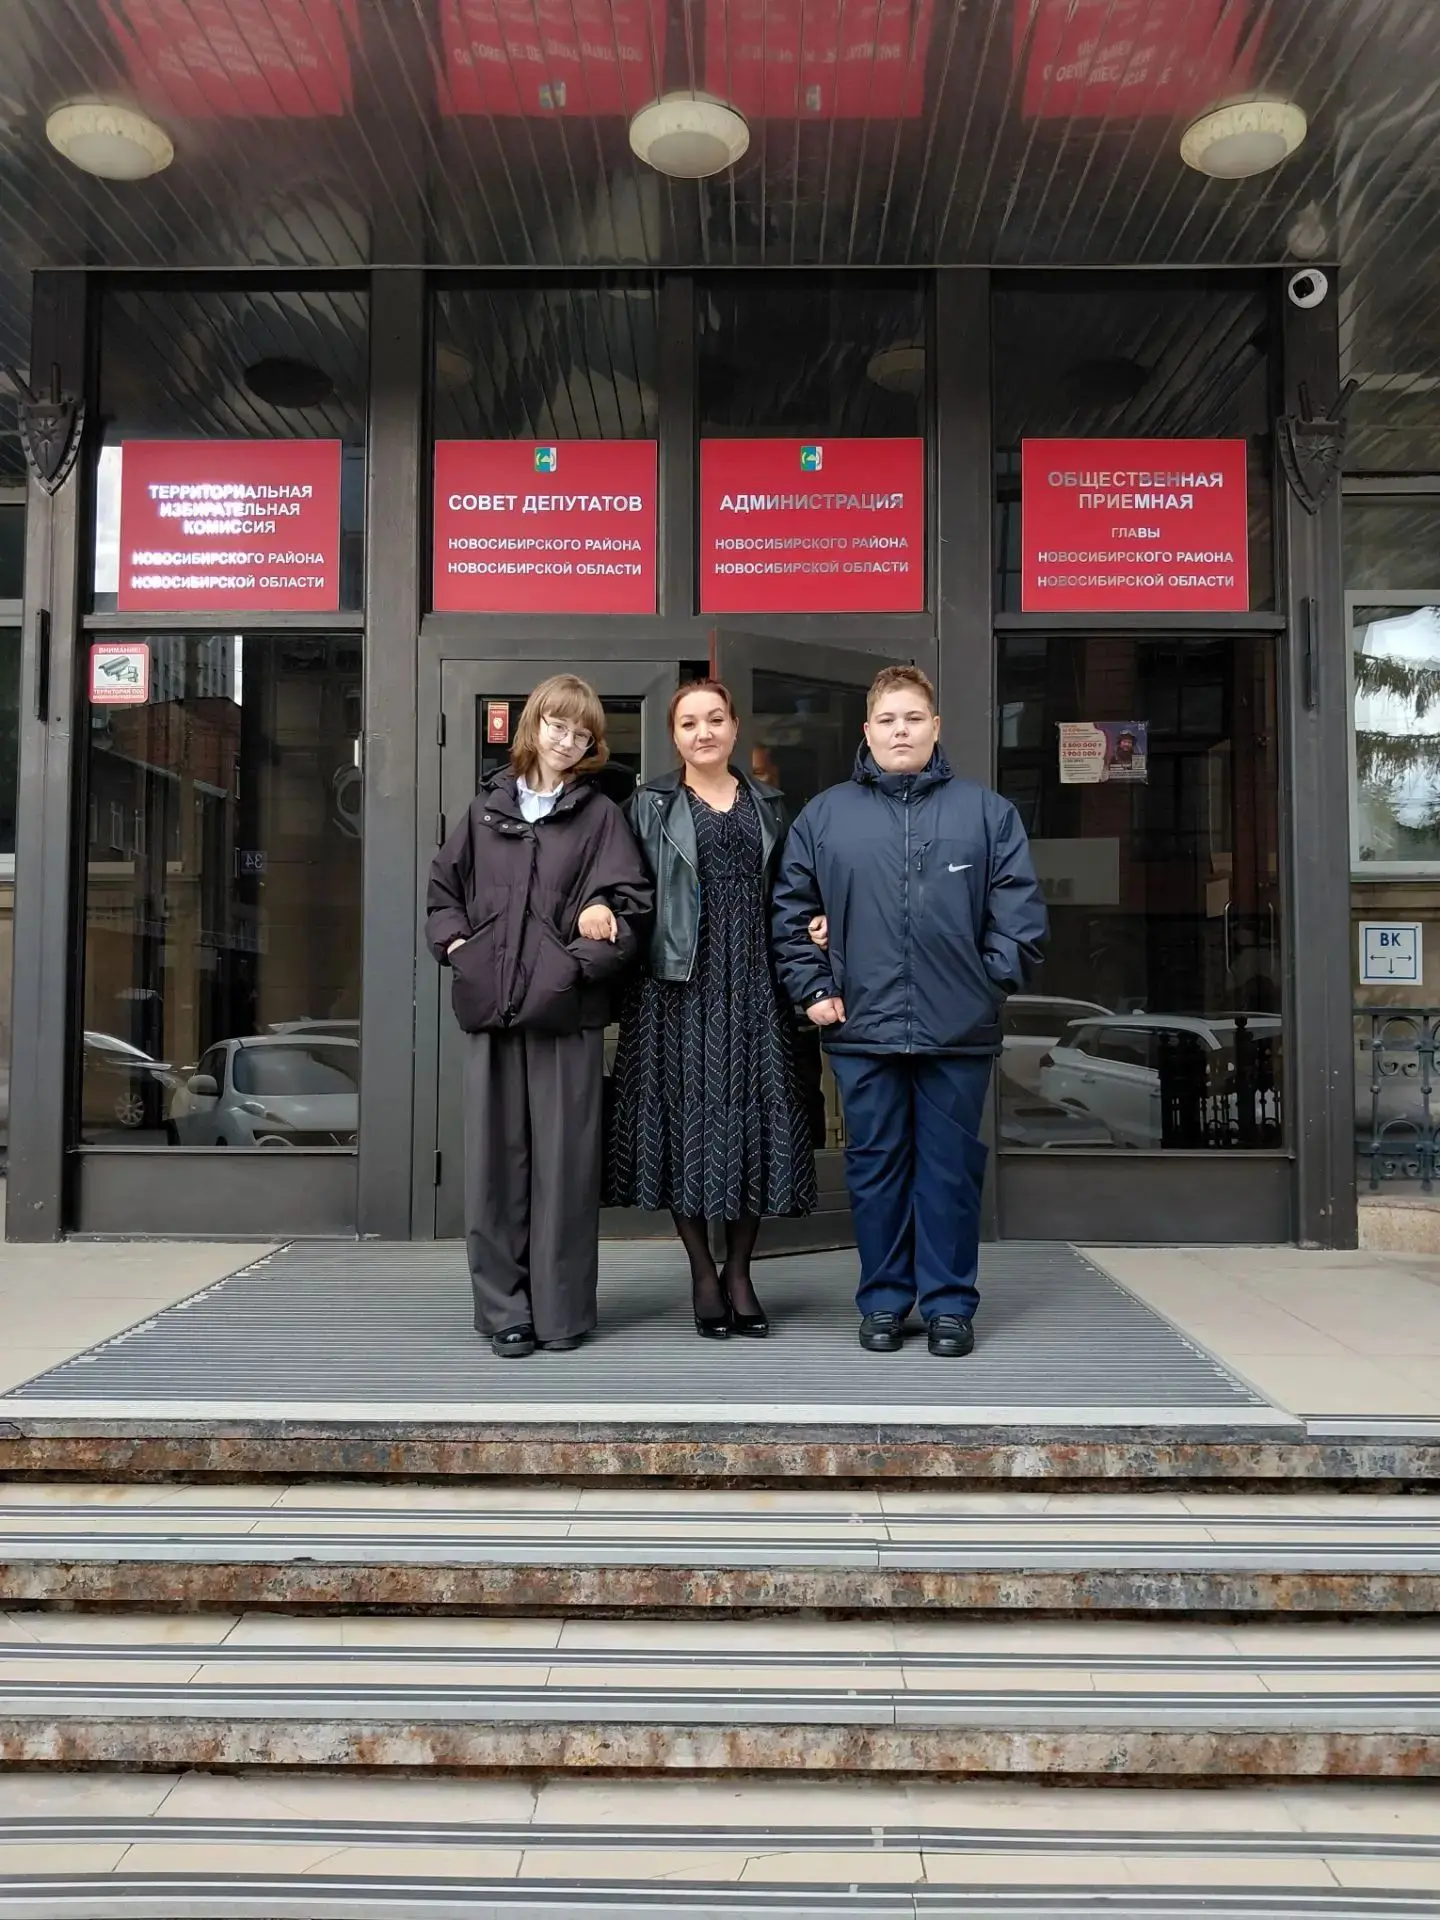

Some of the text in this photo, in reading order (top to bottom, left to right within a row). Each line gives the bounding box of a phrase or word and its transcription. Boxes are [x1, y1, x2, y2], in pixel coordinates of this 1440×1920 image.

[1047, 471, 1224, 489] ОБЩЕСТВЕННАЯ
[148, 484, 312, 500] ТЕРРИТОРИАЛЬНАЯ
[448, 494, 643, 514] СОВЕТ ДЕПУТАТОВ
[719, 493, 904, 513] АДМИНИСТРАЦИЯ
[1079, 493, 1194, 510] ПРИЕМНАЯ
[159, 502, 300, 517] ИЗБИРАТЕЛЬНАЯ
[183, 519, 276, 535] КОМИССИЯ
[1111, 527, 1161, 539] ГЛАВЫ
[448, 537, 642, 551] НОВОСИБИРСКОГО РАЙОНА
[715, 535, 908, 550] НОВОСИБИРСКОГО РАЙОНА
[131, 550, 325, 565] НОВОСИБИРСКОГО РАЙОНА
[1038, 551, 1173, 563] НОВОСИБИРСКОГО
[448, 561, 642, 575] НОВОСИБИРСКОЙ ОБЛАСТИ
[715, 560, 909, 574] НОВОСИБИРСКОЙ ОБЛАСТИ
[131, 574, 325, 589] НОВОСИБИРСКОЙ ОБЛАСТИ
[1037, 573, 1234, 587] НОВОСИБИРСКОЙ ОБЛАСТИ
[1380, 932, 1402, 947] ВК
